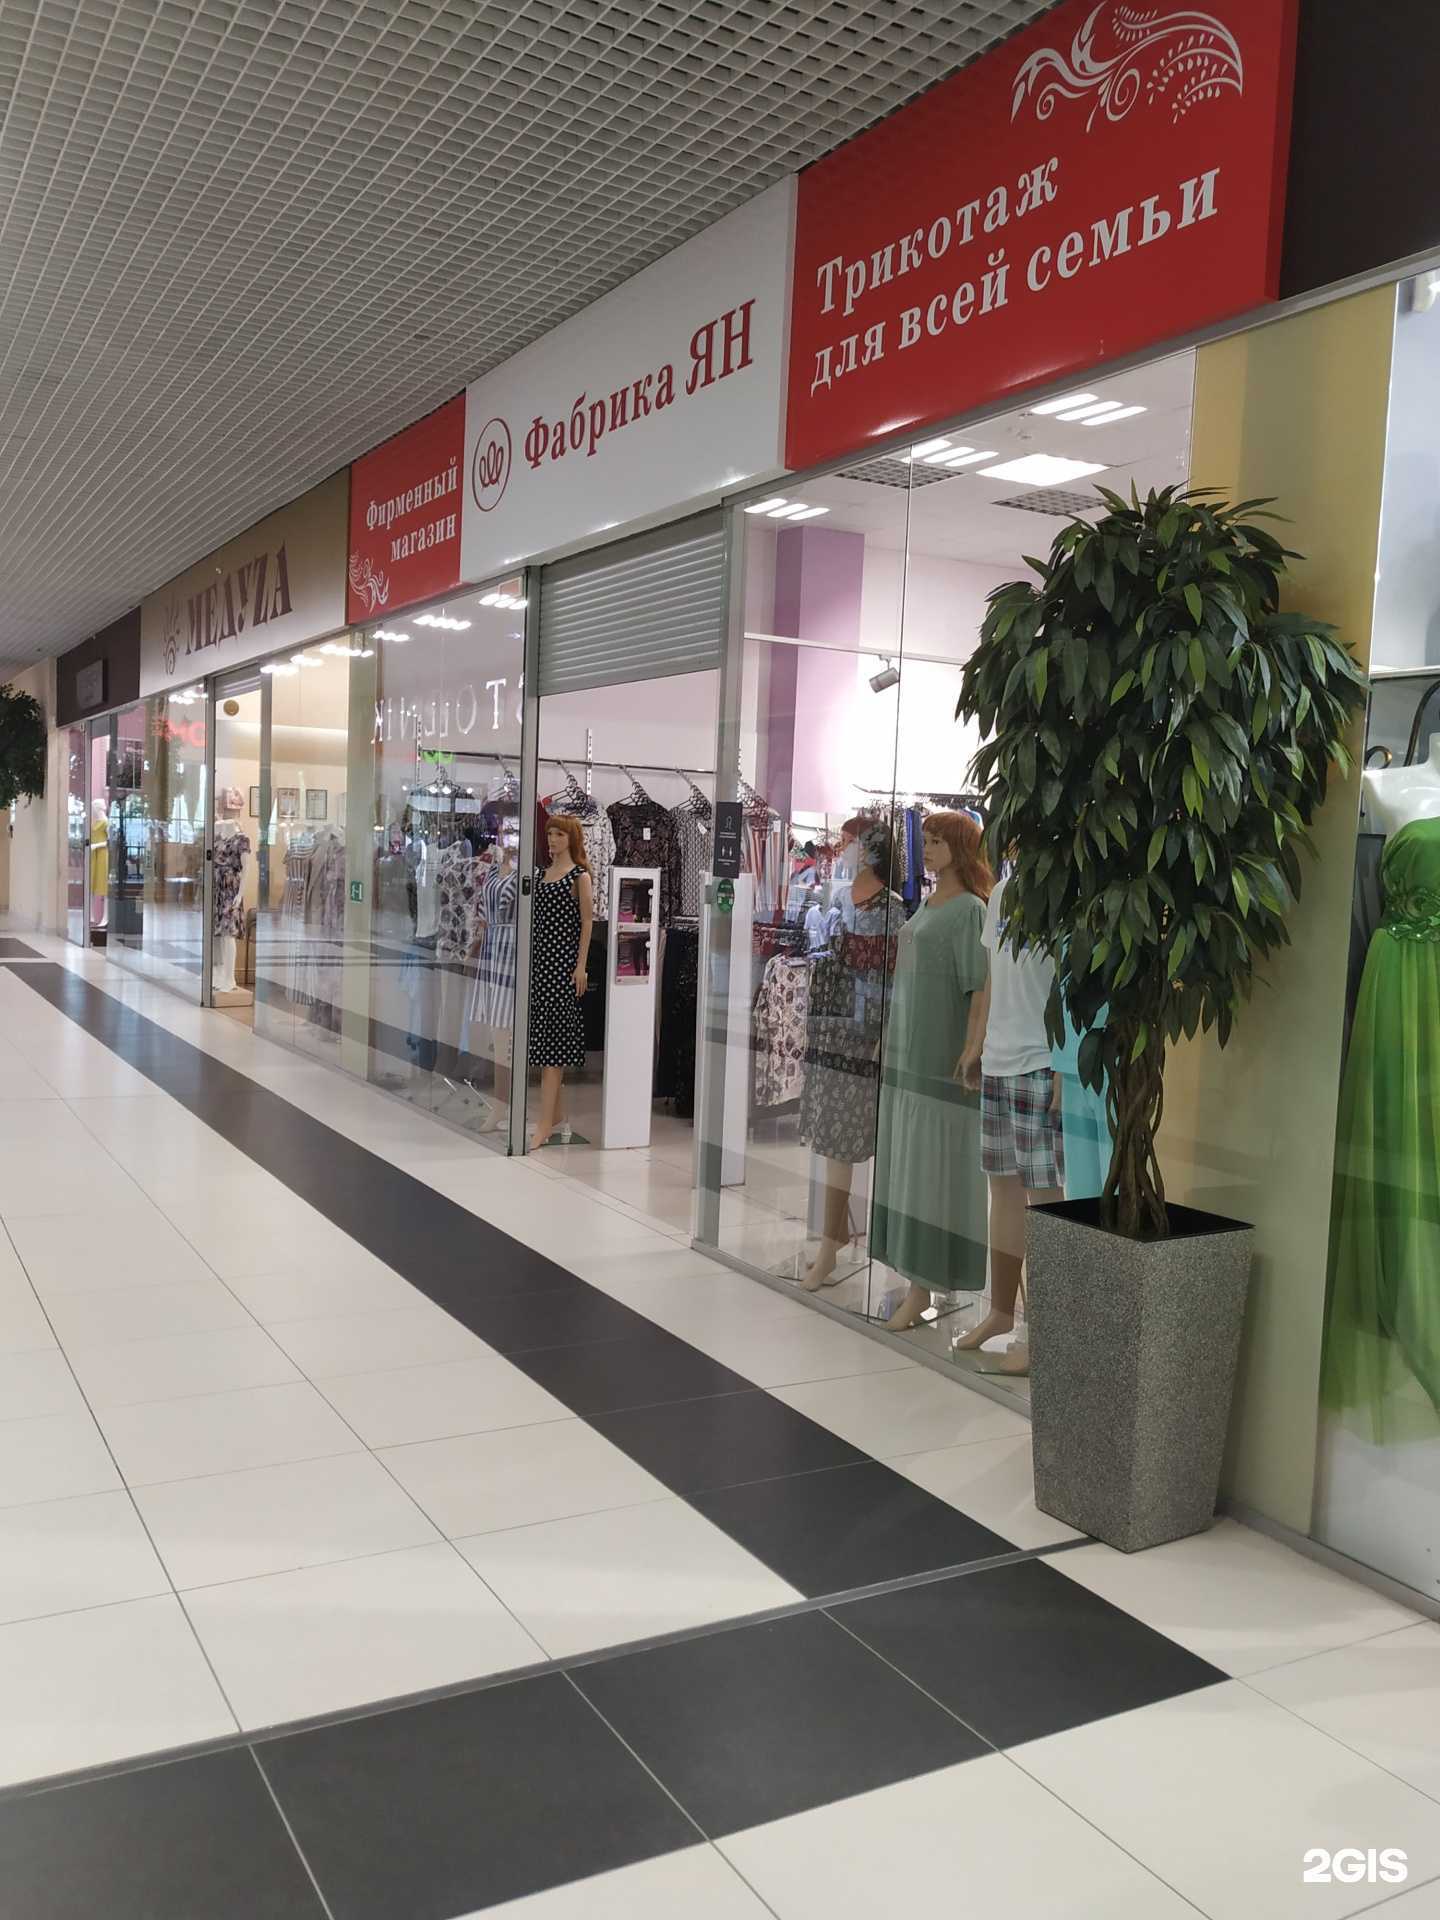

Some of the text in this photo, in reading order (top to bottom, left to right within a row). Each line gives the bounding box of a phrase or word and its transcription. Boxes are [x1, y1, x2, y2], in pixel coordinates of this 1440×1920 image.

[810, 167, 1222, 398] для всей семьи
[815, 155, 1059, 317] Трикотаж
[524, 298, 757, 470] Фабрика ЯН
[366, 455, 458, 562] Фирменный магазин
